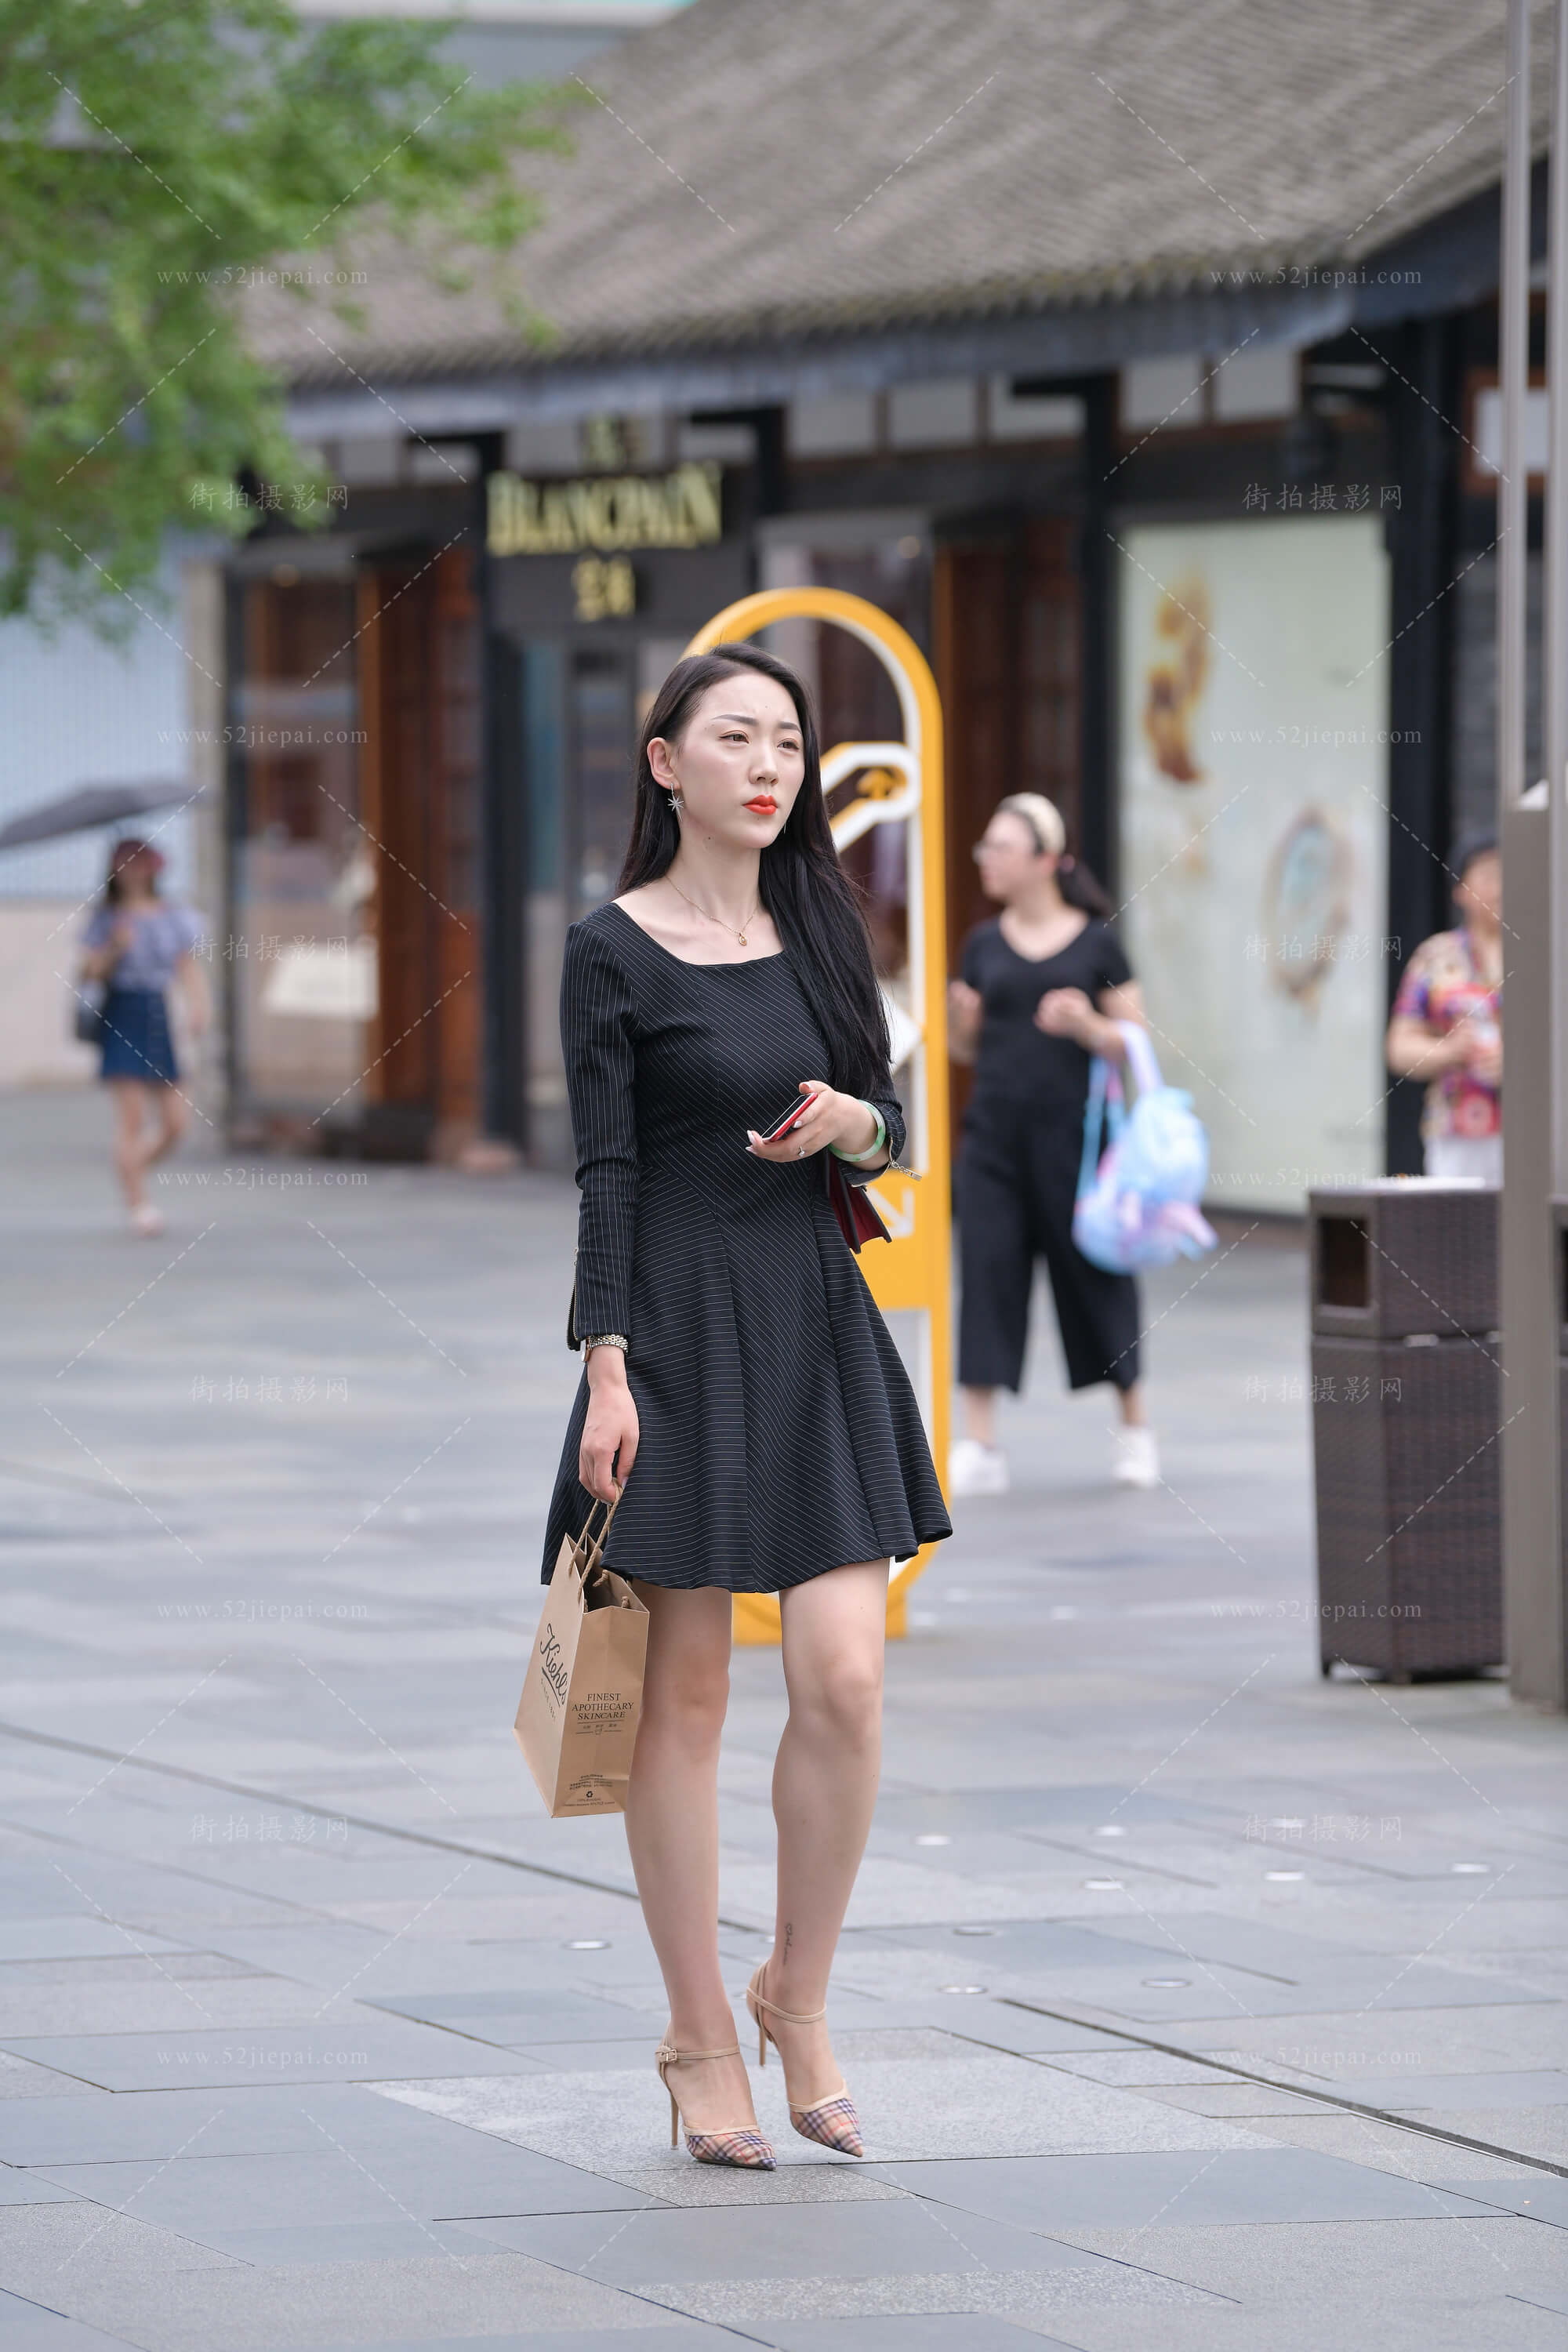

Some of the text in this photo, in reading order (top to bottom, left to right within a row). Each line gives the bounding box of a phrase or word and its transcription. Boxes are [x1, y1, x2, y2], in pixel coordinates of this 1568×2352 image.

[587, 1693, 621, 1702] FINEST
[572, 1702, 634, 1711] APOTHECARY
[578, 1711, 626, 1720] SKINCARE
